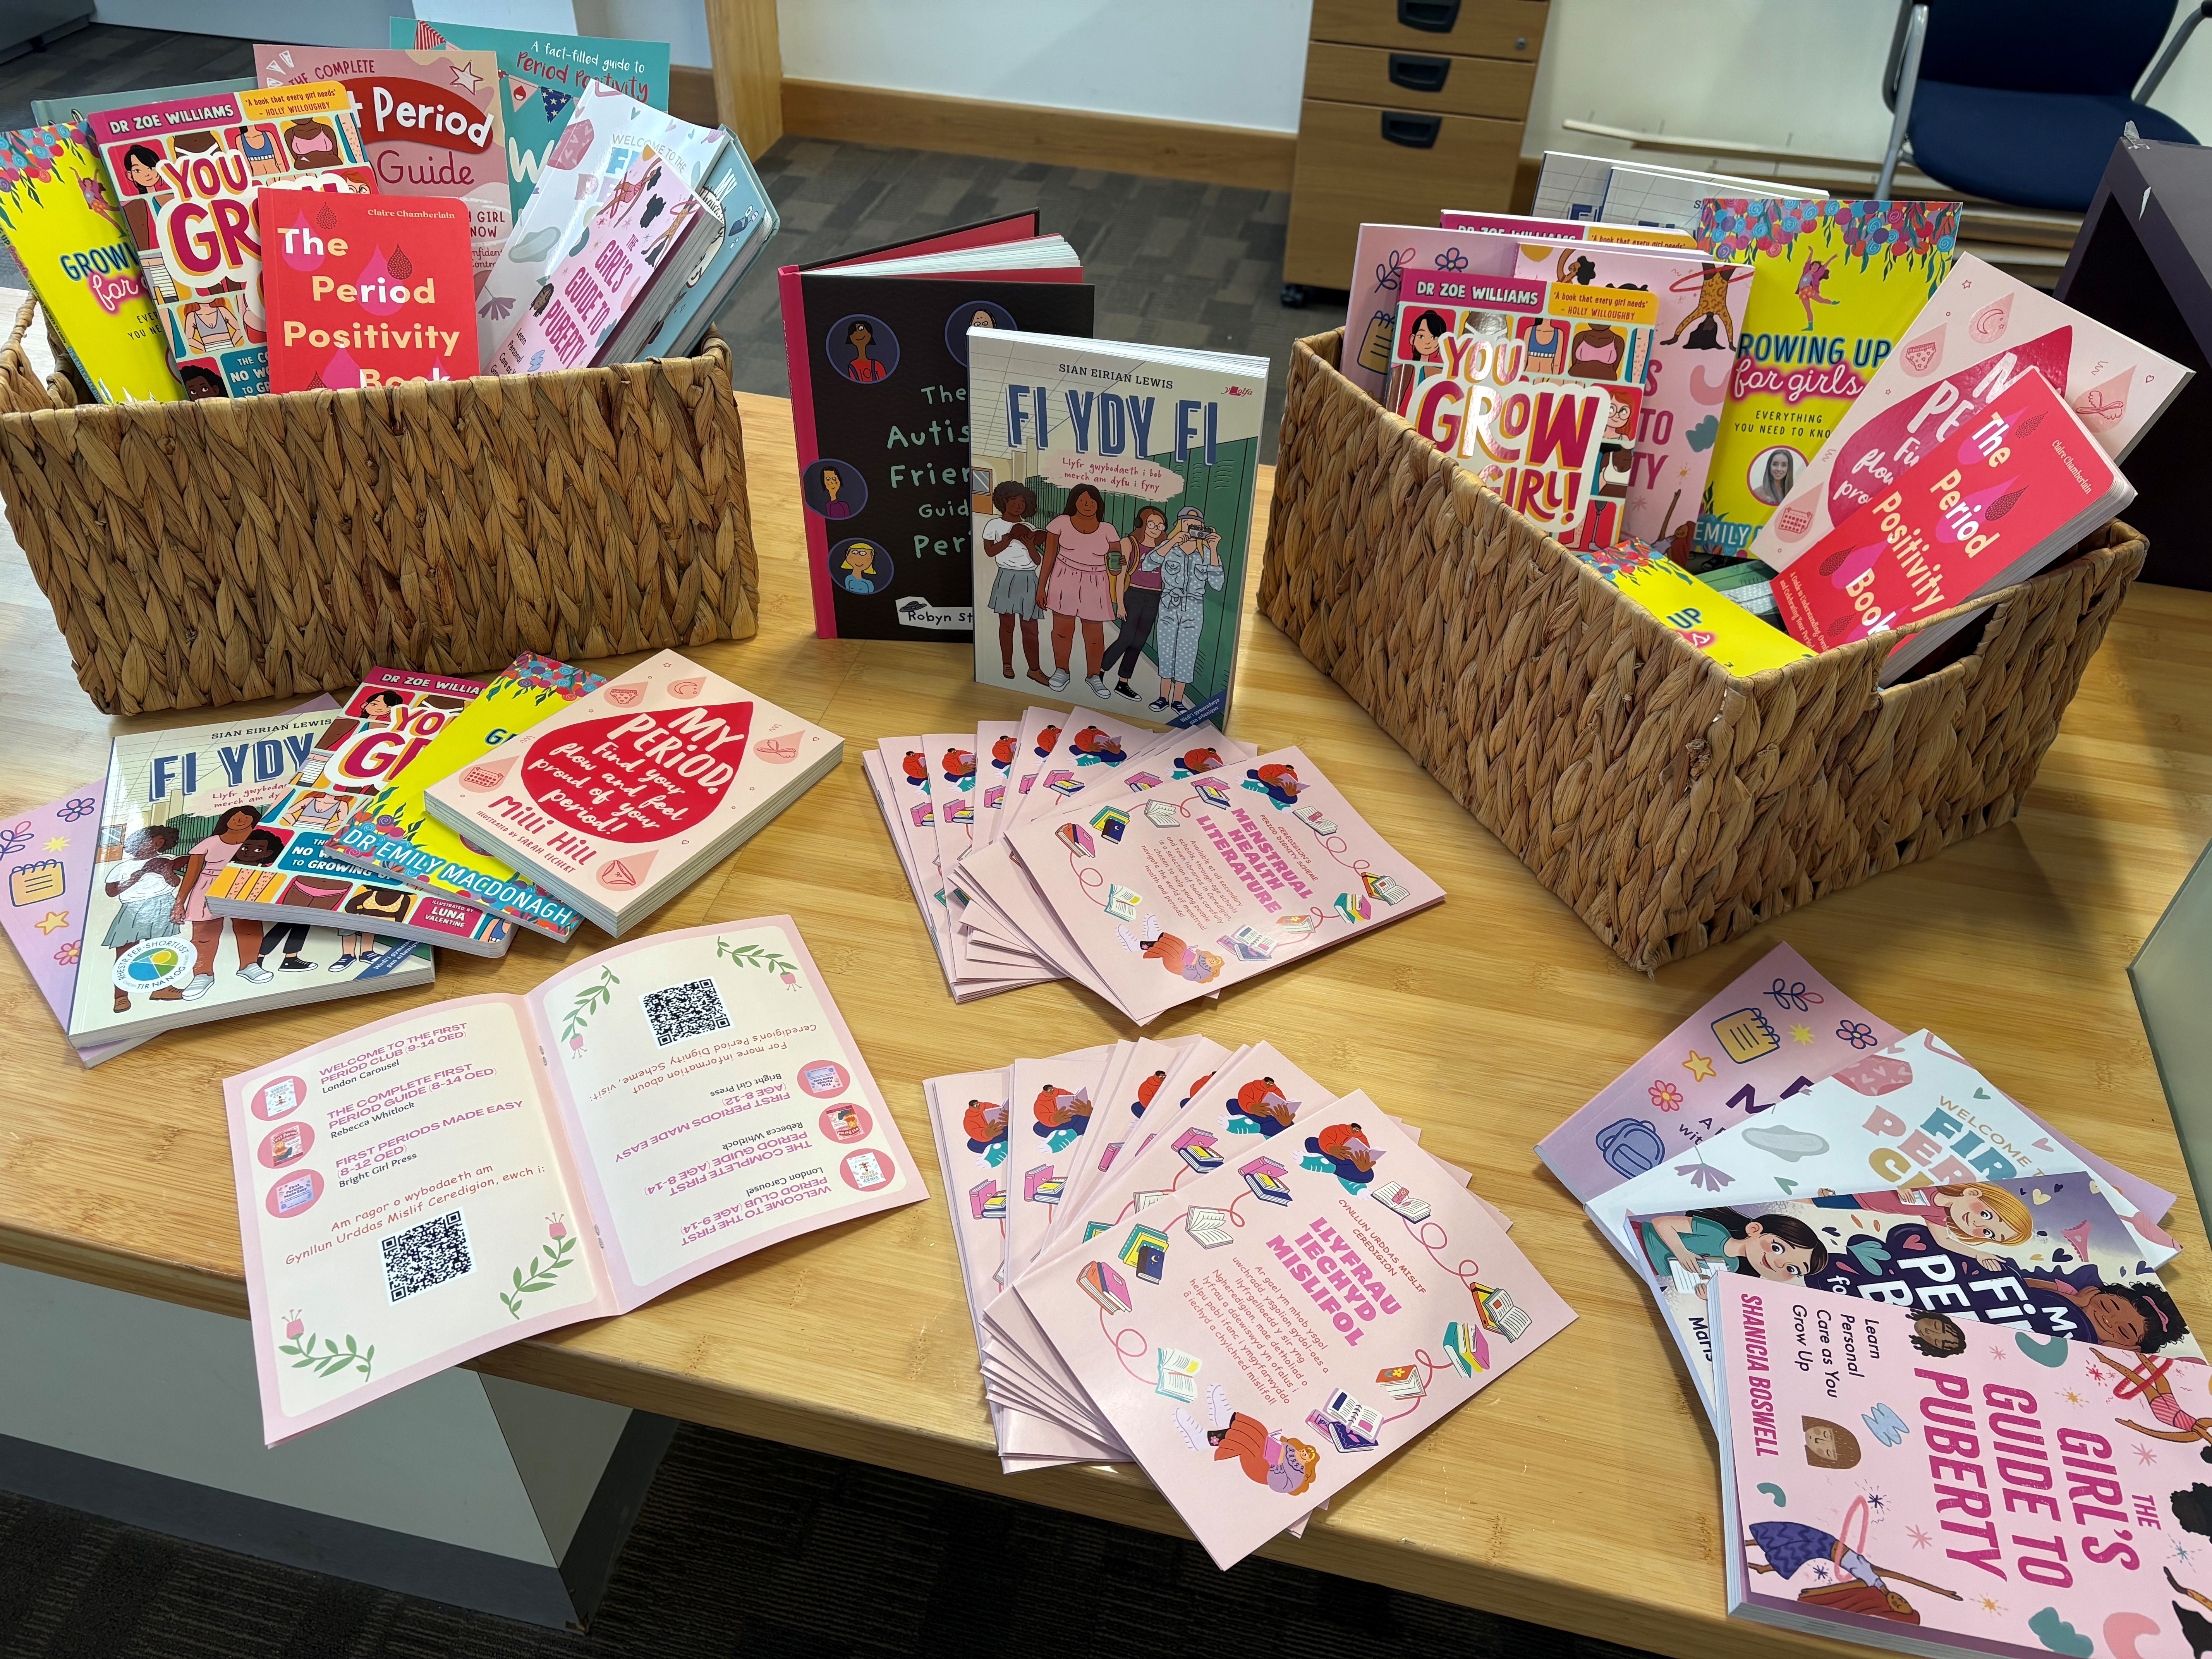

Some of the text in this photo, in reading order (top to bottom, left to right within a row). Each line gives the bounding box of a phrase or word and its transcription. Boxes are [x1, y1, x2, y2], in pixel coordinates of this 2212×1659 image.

[314, 60, 375, 80] COMPLETE
[517, 52, 569, 84] Period
[531, 41, 644, 73] A fact-filled guide to
[110, 104, 234, 134] DR ZOE WILLIAMS
[254, 96, 269, 105] book
[271, 94, 285, 103] that
[287, 93, 304, 103] every
[305, 92, 316, 100] girl
[266, 101, 330, 116] HOLLY WILLOUGHBY
[373, 87, 495, 148] Period
[377, 150, 475, 185] Guide
[612, 134, 687, 173] WELCOME TO THE
[164, 155, 249, 202] YOU
[368, 209, 455, 219] Claire Chamberlain
[277, 228, 348, 256] The
[626, 234, 639, 252] THE
[93, 275, 138, 311] for
[312, 276, 435, 304] Period
[565, 267, 610, 336] GUIDE TO
[1417, 281, 1538, 306] DR ZOE WILLIAMS
[539, 299, 587, 369] PUBERTY
[1568, 306, 1635, 321] HOLLY WILLOUGHBY
[284, 321, 460, 356] Positivity
[507, 340, 525, 364] Personal
[516, 328, 527, 345] Learn
[1853, 338, 1892, 368] UP
[1059, 364, 1173, 389] SIAN EIRIAN LEWIS
[1443, 335, 1523, 384] YOU
[1734, 359, 1864, 402] for girls
[921, 385, 966, 404] The
[1006, 385, 1218, 465] FI YDY FI
[1415, 381, 1601, 470] GROW
[1735, 423, 1804, 436] YOU NEED TO
[1755, 410, 1822, 424] EVERYTHING
[1972, 411, 2011, 468] The
[1062, 458, 1162, 478] Llyfr gwybodaeth i bob
[1065, 471, 1089, 481] merch
[1094, 474, 1106, 483] am
[1111, 475, 1130, 488] dyfu
[1141, 480, 1160, 493] fyny
[2052, 440, 2092, 494] Claire Chamberlain
[919, 499, 969, 518] Guid
[1930, 468, 2000, 558] Period
[1694, 526, 1750, 546] EMILY
[1872, 490, 1945, 613] Positivity
[908, 610, 951, 627] Robyn
[211, 719, 332, 739] SIAN EIRIAN LEWIS
[1194, 699, 1220, 716] gymeradwyo
[667, 707, 744, 752] MY
[149, 732, 314, 802] FI YDY
[549, 743, 689, 821] flow and feel
[592, 742, 685, 795] Find your
[527, 758, 660, 829] proud of your
[537, 788, 628, 835] period!
[488, 795, 597, 866] Milli Hill
[1259, 814, 1319, 881] PERIOD DIGNITY SCHEME
[517, 836, 576, 874] SARAH EICHERT
[1196, 815, 1283, 914] LITERATURE
[1227, 828, 1285, 890] HEALTH
[1231, 807, 1314, 899] MENSTRUAL
[343, 829, 576, 925] DR EMILY MACDONAGH
[424, 914, 465, 928] VALENTINE
[431, 905, 465, 921] LUNA
[117, 958, 130, 980] RHESTR
[128, 946, 143, 957] FER
[146, 941, 189, 953] SHORTLIST
[319, 1023, 467, 1076] WELCOME TO THE FIRST
[320, 1030, 467, 1084] PERIOD CLUB (9-14 OED)
[590, 1024, 817, 1102] Ceredigion's Period Dignity Scheme, visit:
[322, 1059, 400, 1094] London Carousel
[331, 1220, 351, 1232] Am
[356, 1202, 390, 1224] ragor
[404, 1171, 472, 1202] wybodaeth
[476, 1165, 493, 1178] am
[1309, 1216, 1402, 1315] LLYFRAU
[1338, 1199, 1427, 1293] CYNLLUN URDDAS MISLIF
[1352, 1228, 1397, 1276] CEREDIGION
[1266, 1235, 1364, 1346] MISLIFOL
[1295, 1231, 1376, 1321] IECHYD
[1792, 1304, 1810, 1372] Grow Up
[1840, 1314, 1865, 1377] Personal
[1864, 1319, 1881, 1359] Learn
[1740, 1294, 1780, 1457] SHANICIA BOSWELL
[1913, 1367, 2008, 1583] PUBERTY
[1981, 1382, 2073, 1589] GUIDE TO
[2056, 1427, 2141, 1571] GIRL'S
[2130, 1495, 2161, 1531] THE
